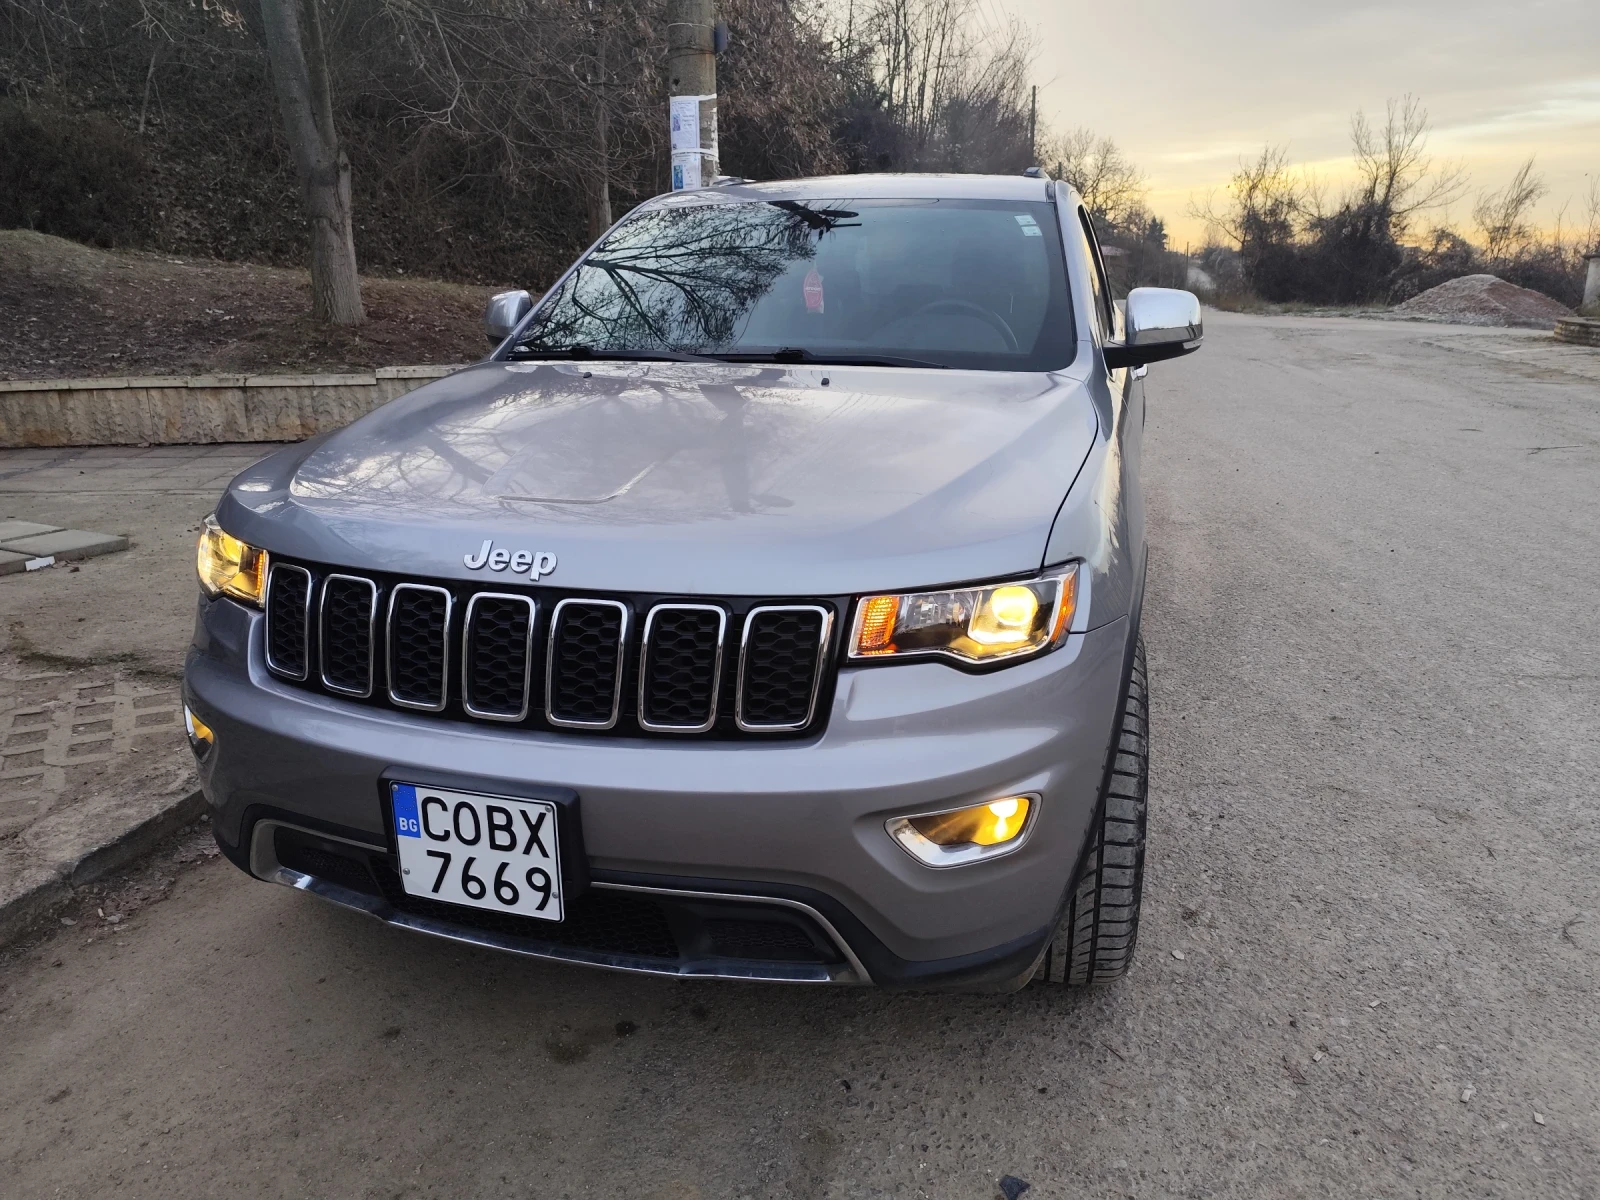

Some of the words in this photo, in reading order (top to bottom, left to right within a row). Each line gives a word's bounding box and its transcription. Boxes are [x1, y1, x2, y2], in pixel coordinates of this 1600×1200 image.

[463, 540, 558, 582] Jeep
[399, 817, 418, 832] BG
[421, 796, 550, 859] COBX
[426, 850, 552, 911] 7669
